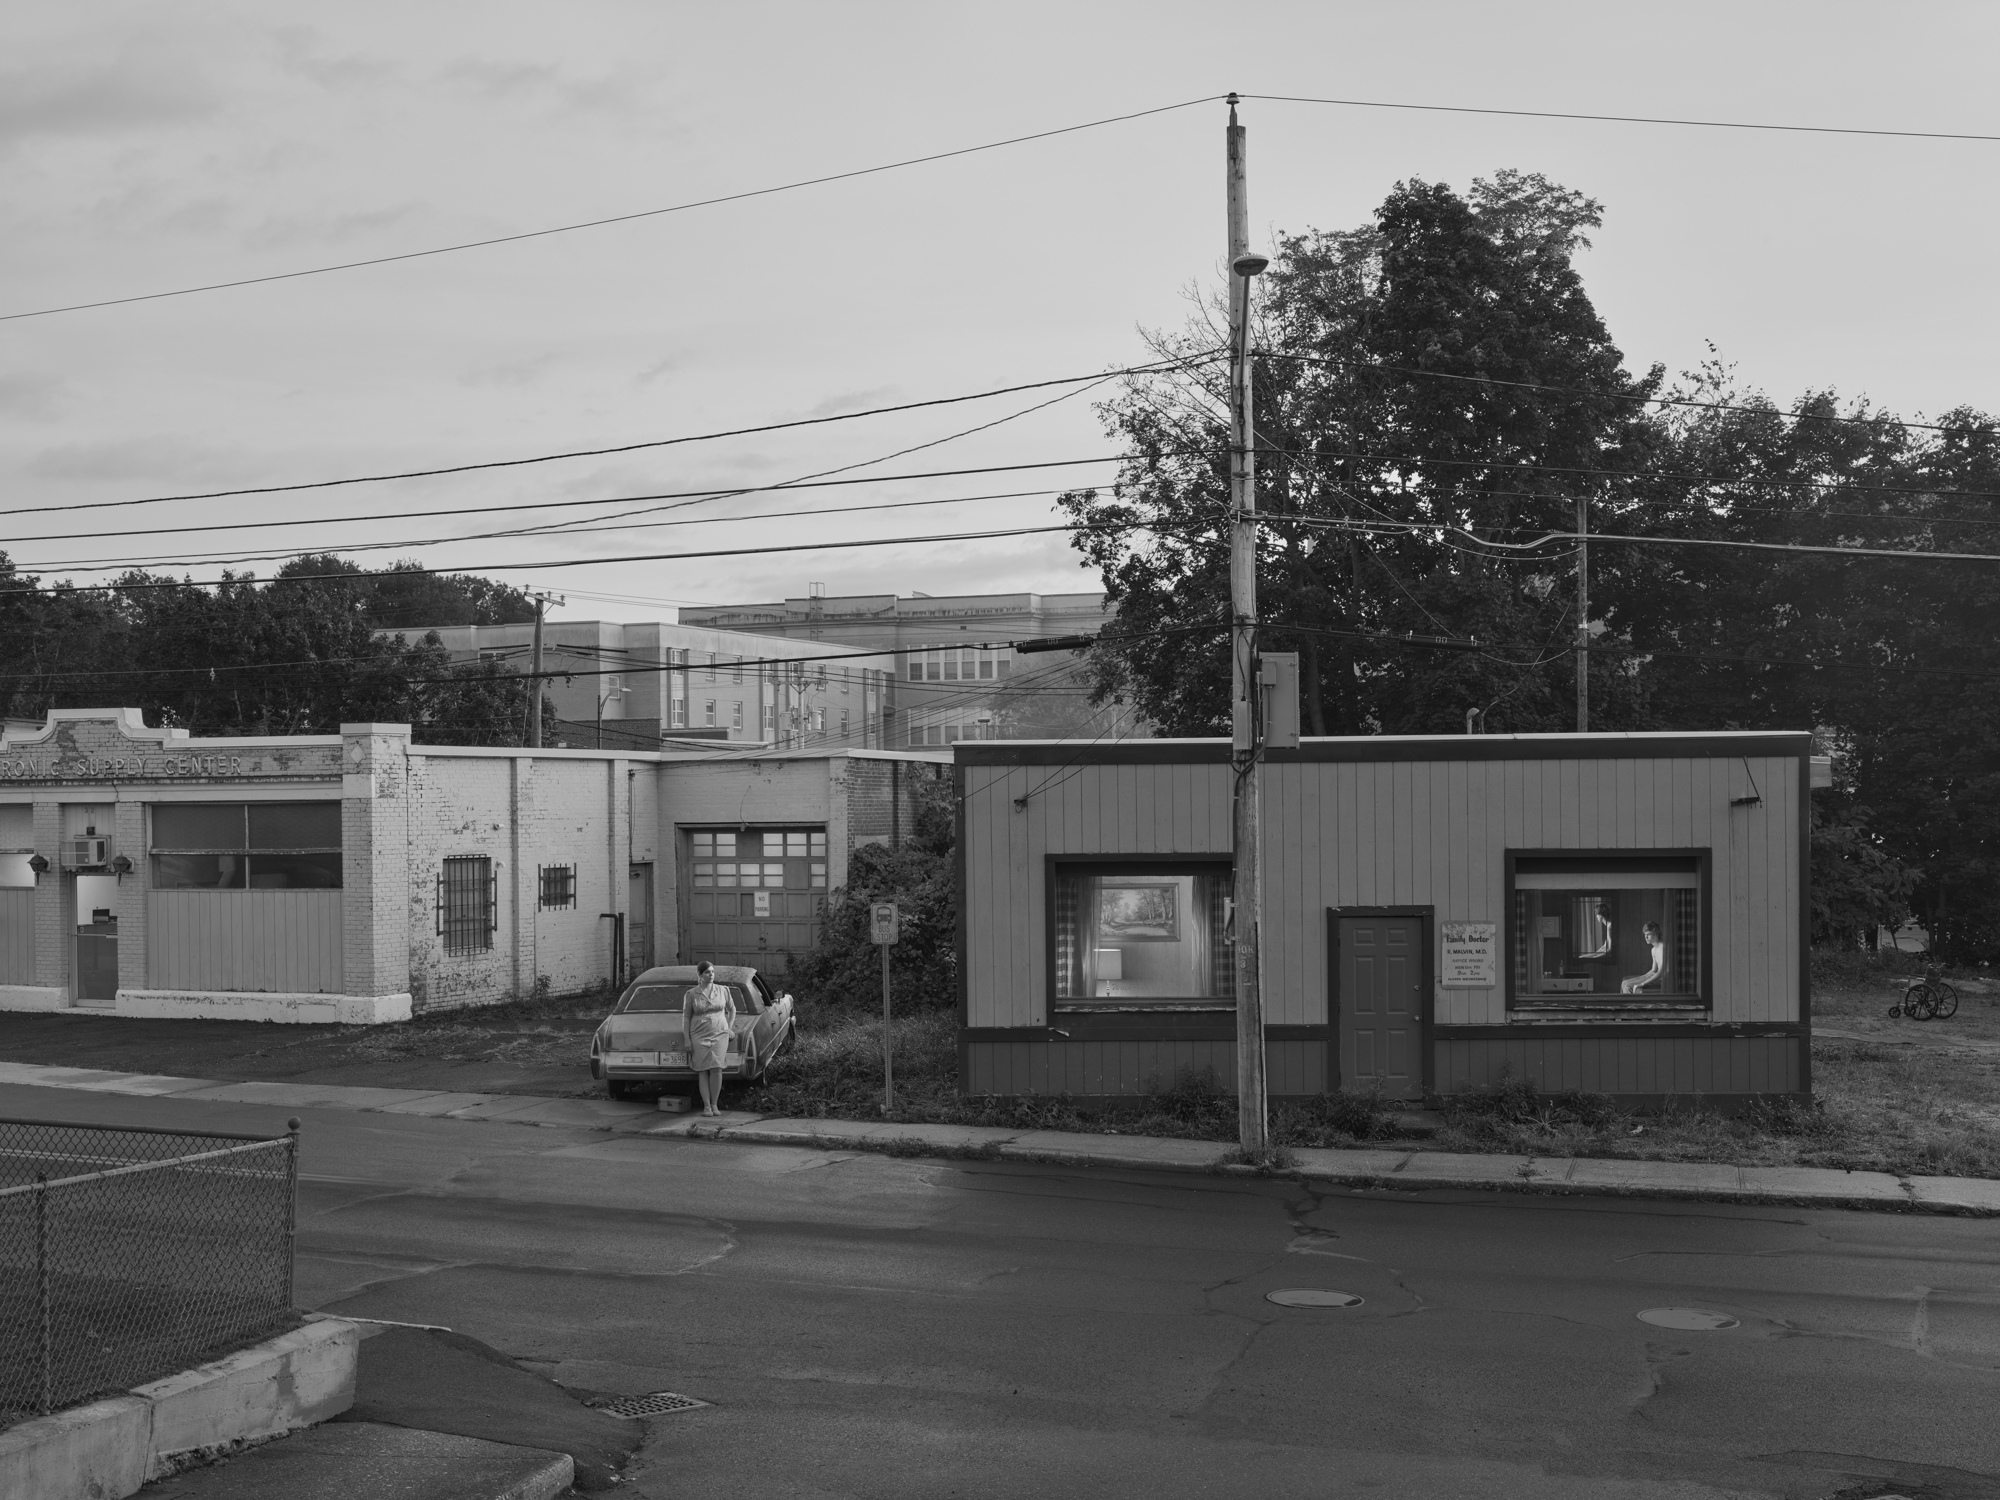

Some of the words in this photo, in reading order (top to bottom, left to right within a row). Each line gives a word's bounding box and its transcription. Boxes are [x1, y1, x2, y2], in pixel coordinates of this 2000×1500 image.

[76, 758, 148, 776] SUPPLY
[165, 756, 242, 775] CENTER
[878, 925, 890, 933] BUS
[877, 933, 893, 941] STOP
[1447, 934, 1465, 944] Family
[1469, 934, 1489, 942] Doctor
